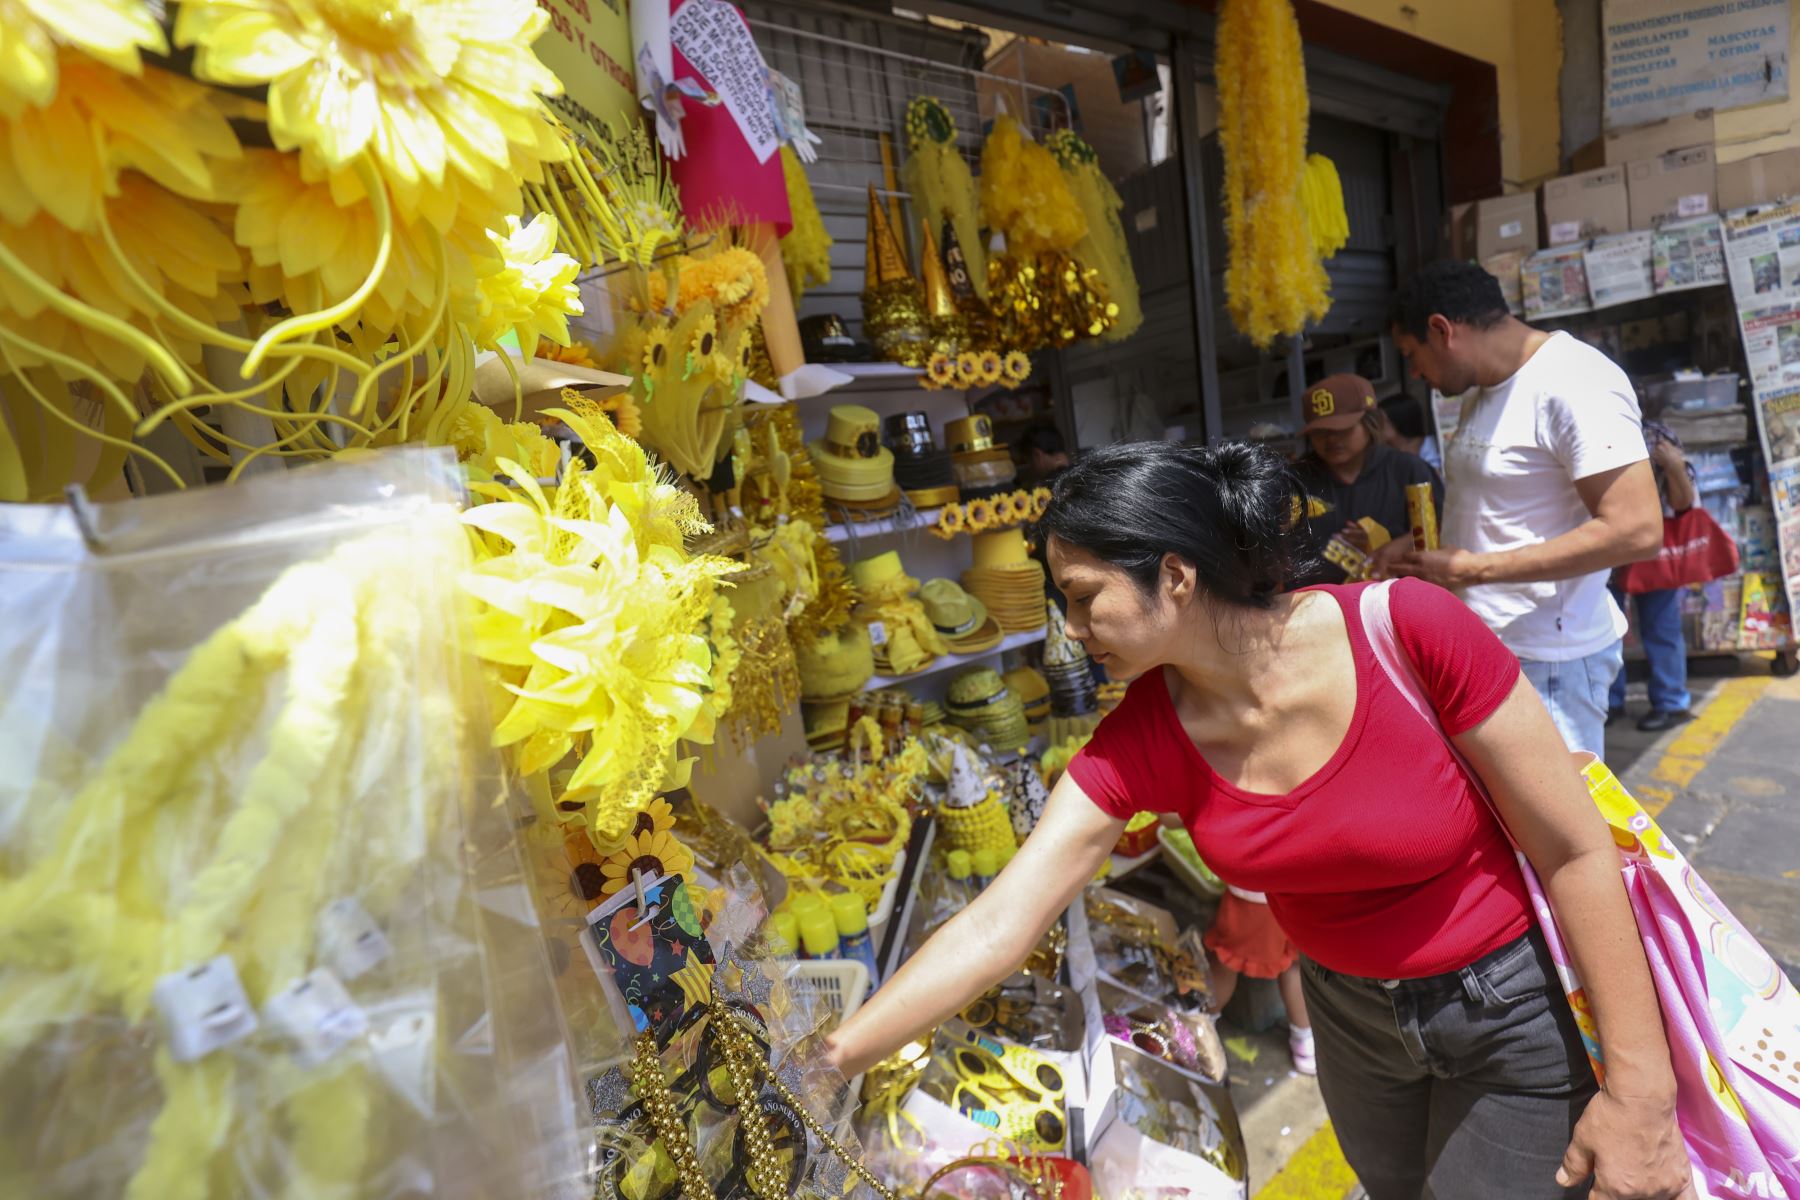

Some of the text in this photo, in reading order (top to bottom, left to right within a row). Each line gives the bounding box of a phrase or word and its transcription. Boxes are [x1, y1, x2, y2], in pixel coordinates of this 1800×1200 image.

[1611, 29, 1690, 50] AMBULANTES
[1706, 25, 1776, 47] MASCOTAS
[1611, 46, 1671, 64] TRICICLOS
[1719, 42, 1760, 58] OTROS
[676, 14, 701, 41] CON
[699, 40, 712, 54] 10
[745, 115, 759, 134] NO
[686, 4, 772, 140] QUE ME CORRESPONDE
[1611, 58, 1677, 78] BICICLETAS
[731, 1006, 766, 1038] AÑO NUEVO
[762, 1099, 801, 1130] AÑO NUEVO
